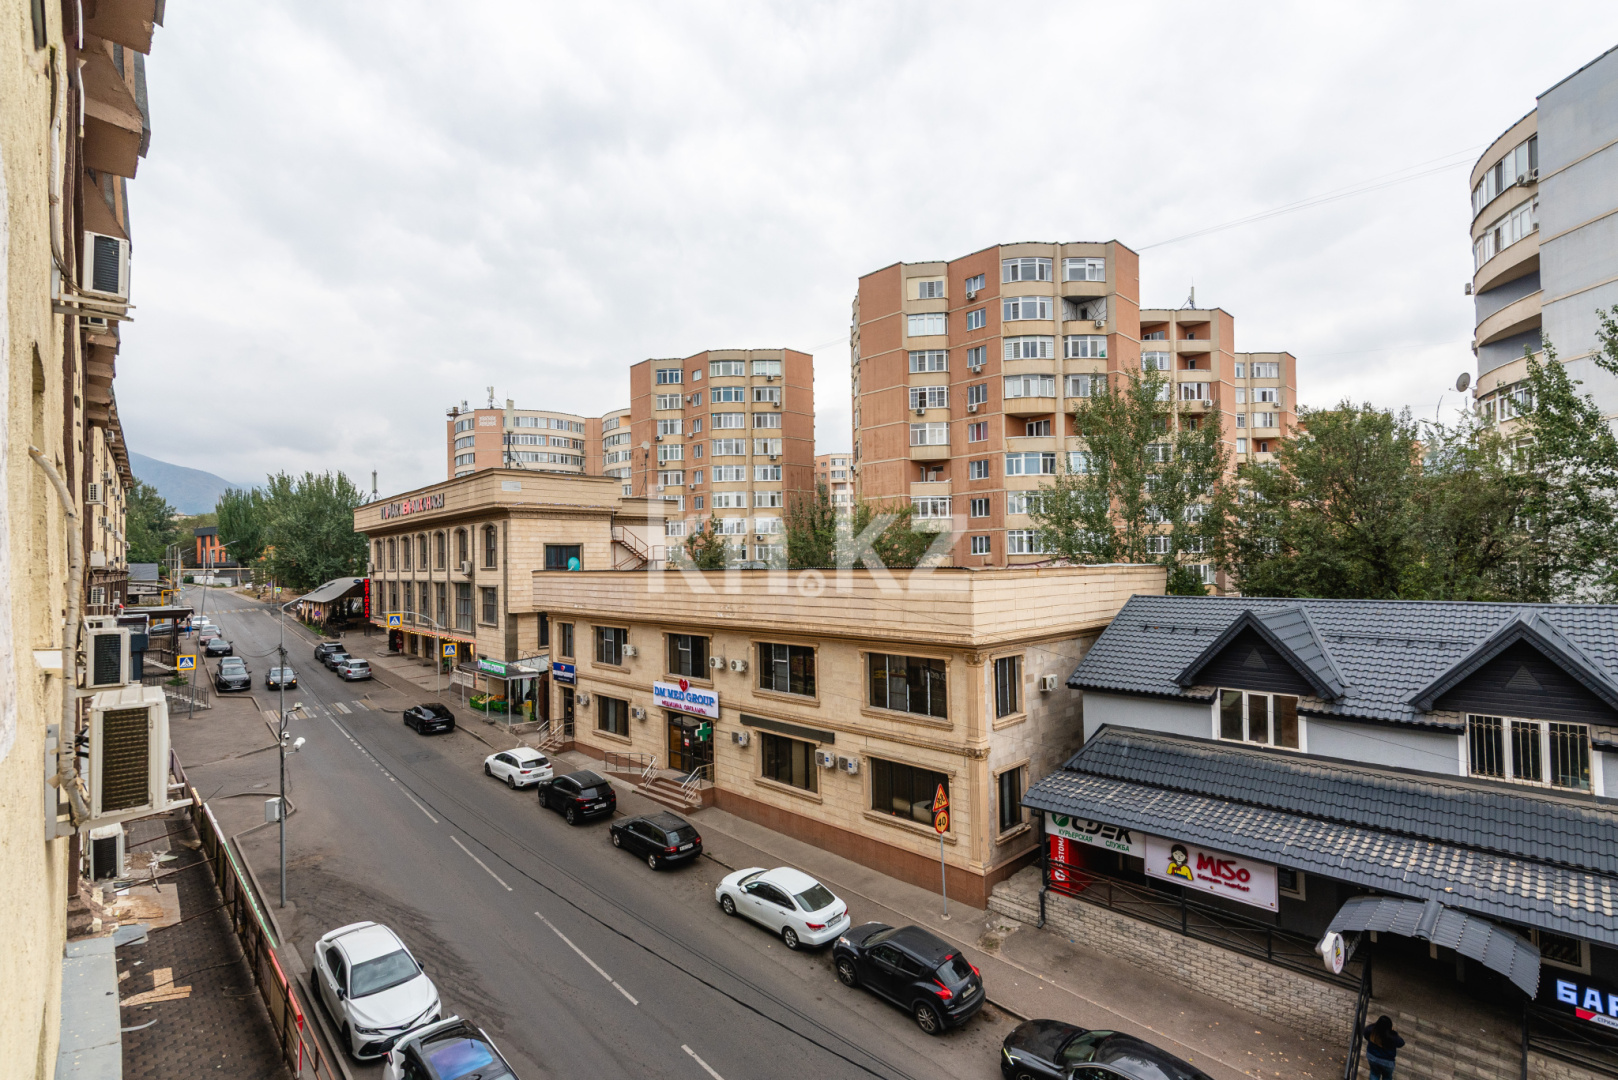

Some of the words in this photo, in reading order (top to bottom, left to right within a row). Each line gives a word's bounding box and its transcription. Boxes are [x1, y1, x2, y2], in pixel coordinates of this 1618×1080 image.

[654, 686, 666, 697] DM
[667, 688, 685, 701] MED
[686, 692, 715, 707] GROUP
[937, 816, 947, 827] 40
[1058, 828, 1093, 843] КУРЬЕРСКАЯ
[1105, 840, 1130, 852] СЛУЖБА
